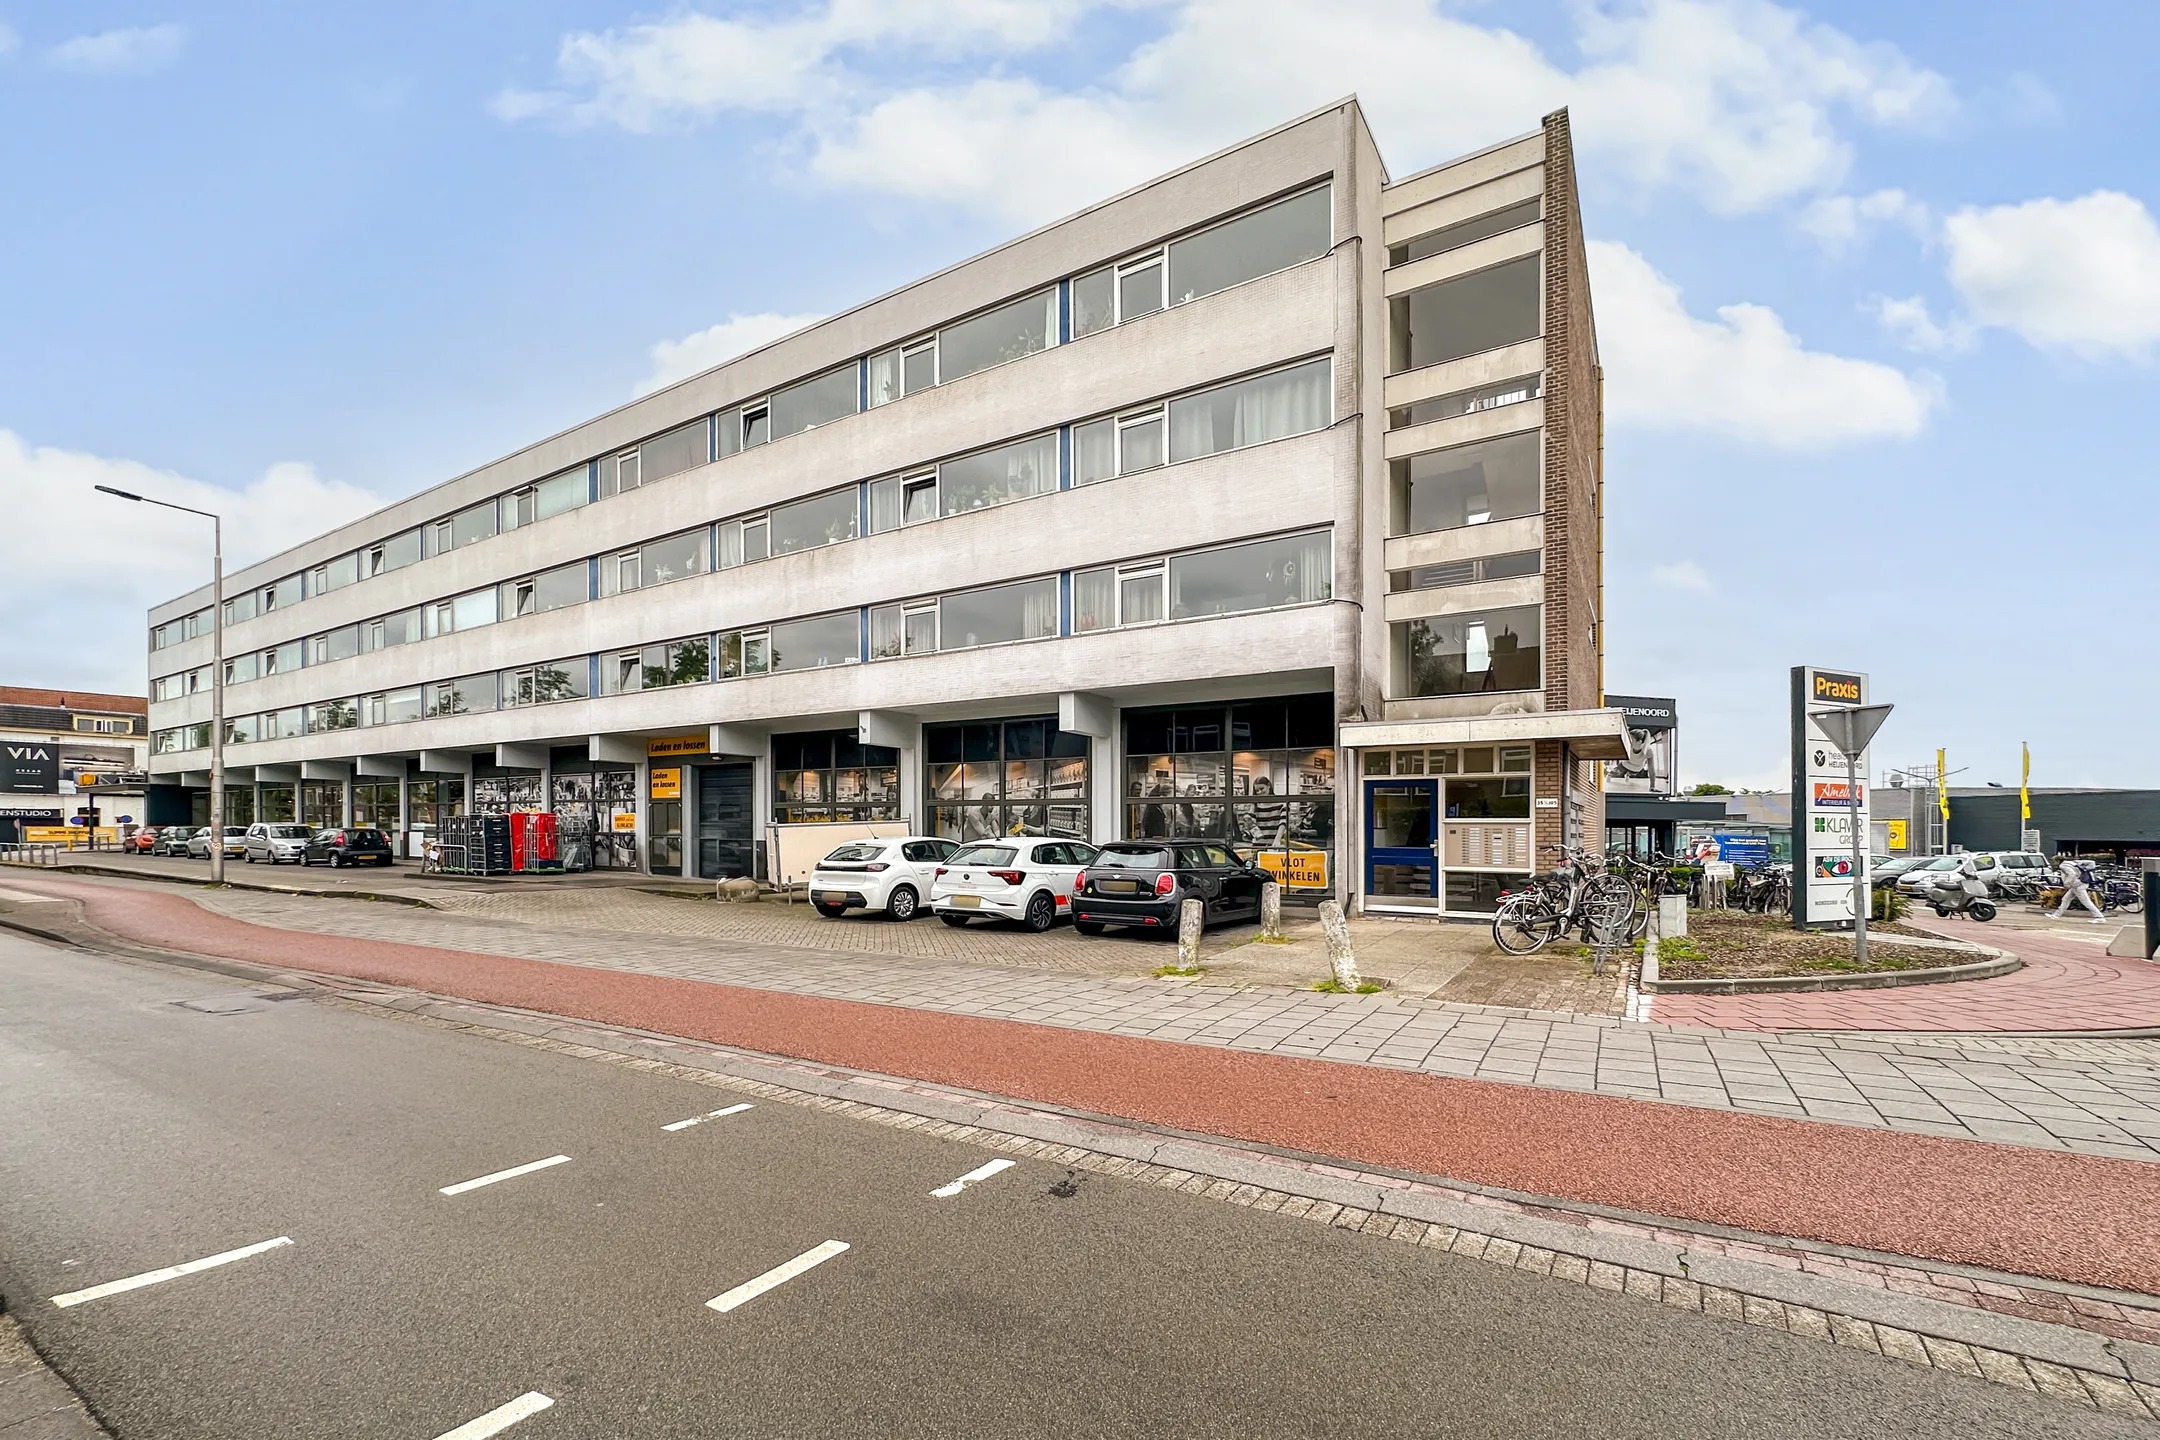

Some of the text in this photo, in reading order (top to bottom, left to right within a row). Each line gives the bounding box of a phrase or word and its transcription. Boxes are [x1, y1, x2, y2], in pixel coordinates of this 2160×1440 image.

[1816, 677, 1858, 699] Praxis
[652, 741, 705, 752] Laden en lossen
[7, 747, 50, 760] VIA
[1829, 761, 1862, 769] HEIJENRD
[1827, 818, 1863, 833] KLAVR
[1840, 835, 1862, 844] GROP
[1281, 858, 1305, 867] VLOT
